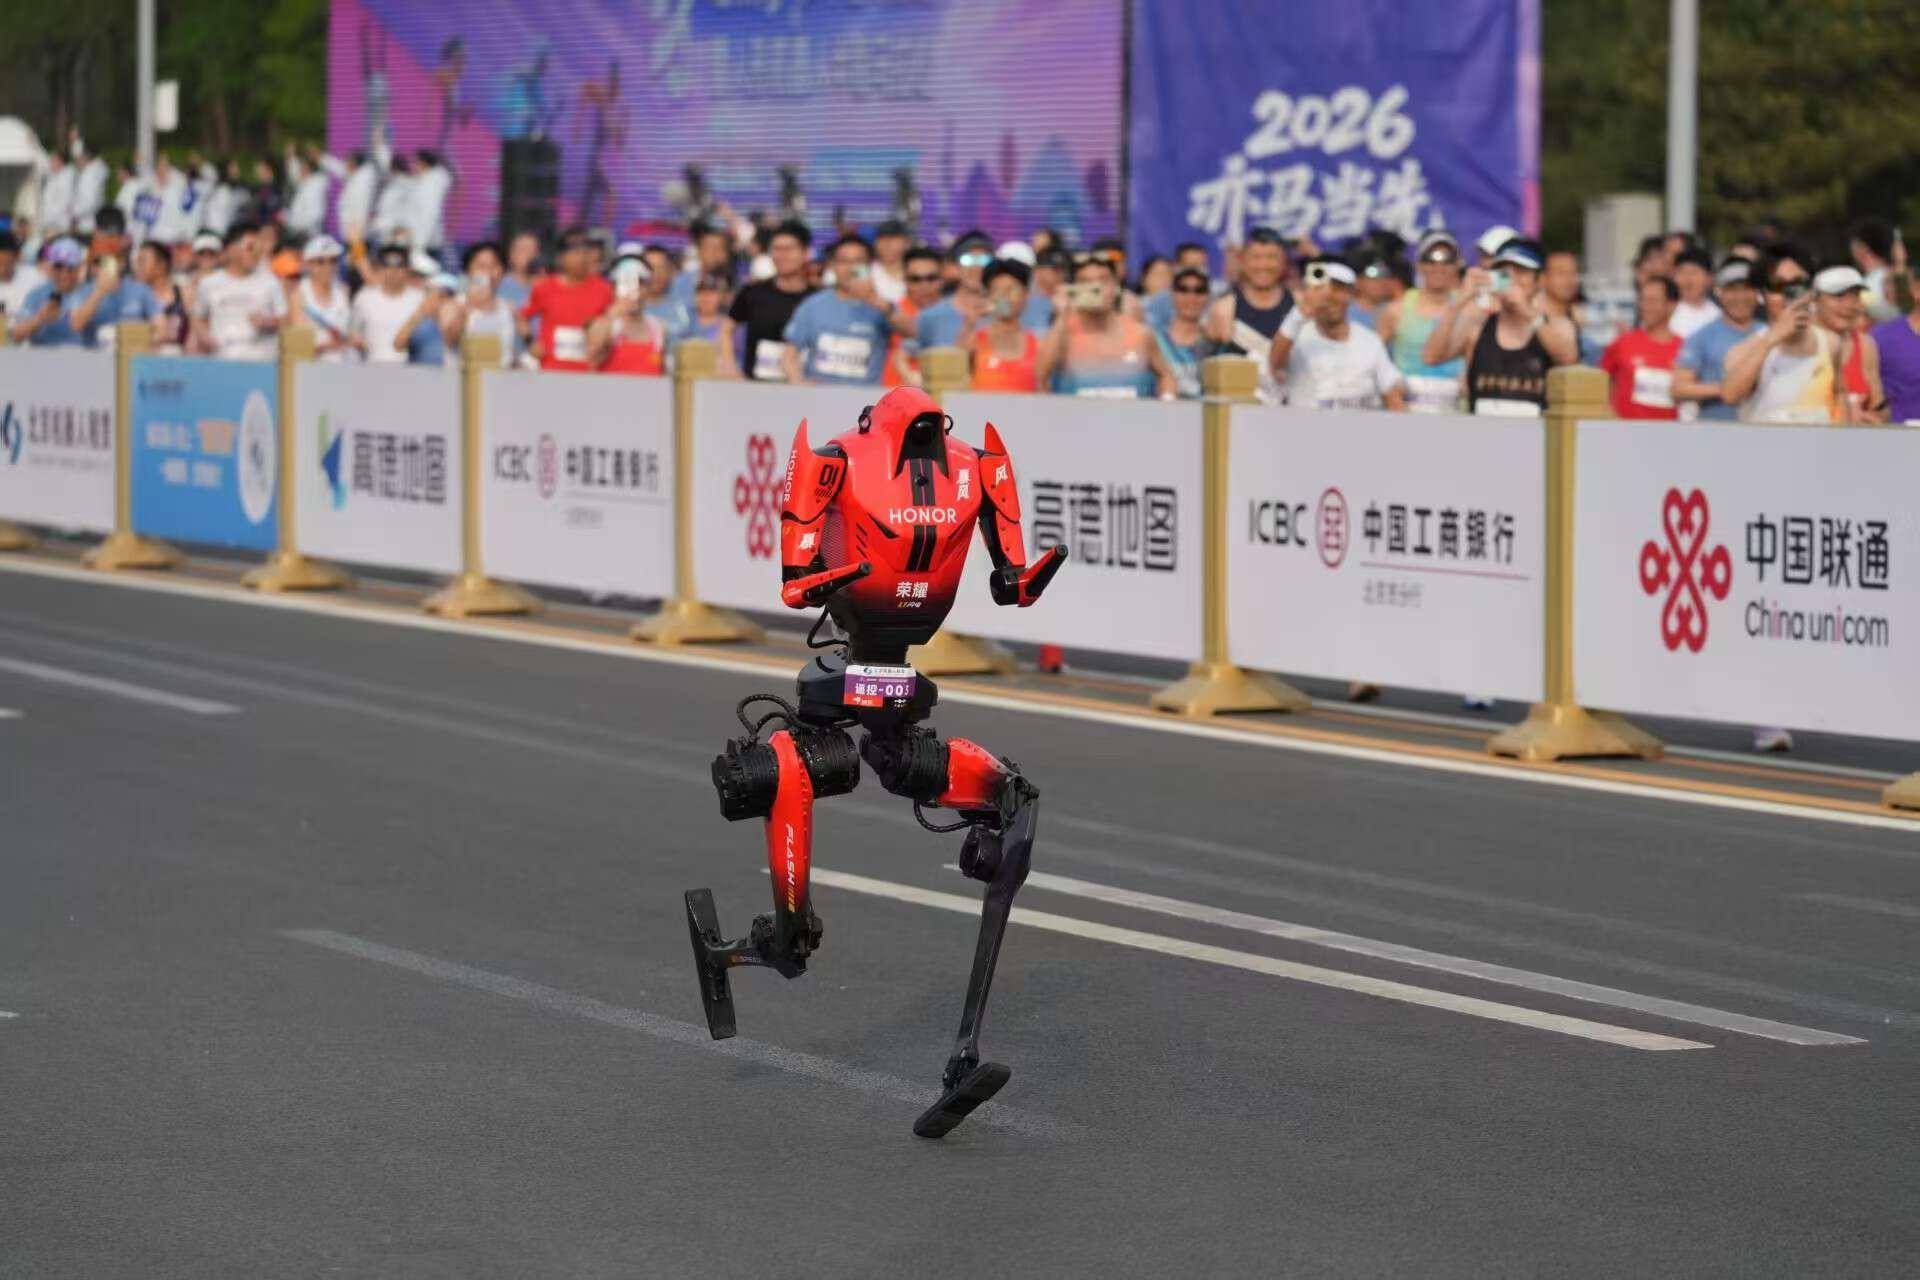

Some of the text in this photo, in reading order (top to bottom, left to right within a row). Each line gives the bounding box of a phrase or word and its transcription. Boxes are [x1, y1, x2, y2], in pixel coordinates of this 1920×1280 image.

[1243, 85, 1415, 159] 2026
[1187, 154, 1445, 247] 亦马当先
[783, 449, 797, 503] HONOR
[889, 508, 957, 524] HONOR
[1034, 480, 1176, 572] 高德地图
[1249, 501, 1307, 547] ICBC
[1364, 501, 1515, 565] 中国工商银行
[1745, 512, 1890, 591] 中国联通
[895, 581, 929, 599] 荣耀
[1745, 598, 1890, 648] China unicom
[785, 823, 796, 886] FLASH
